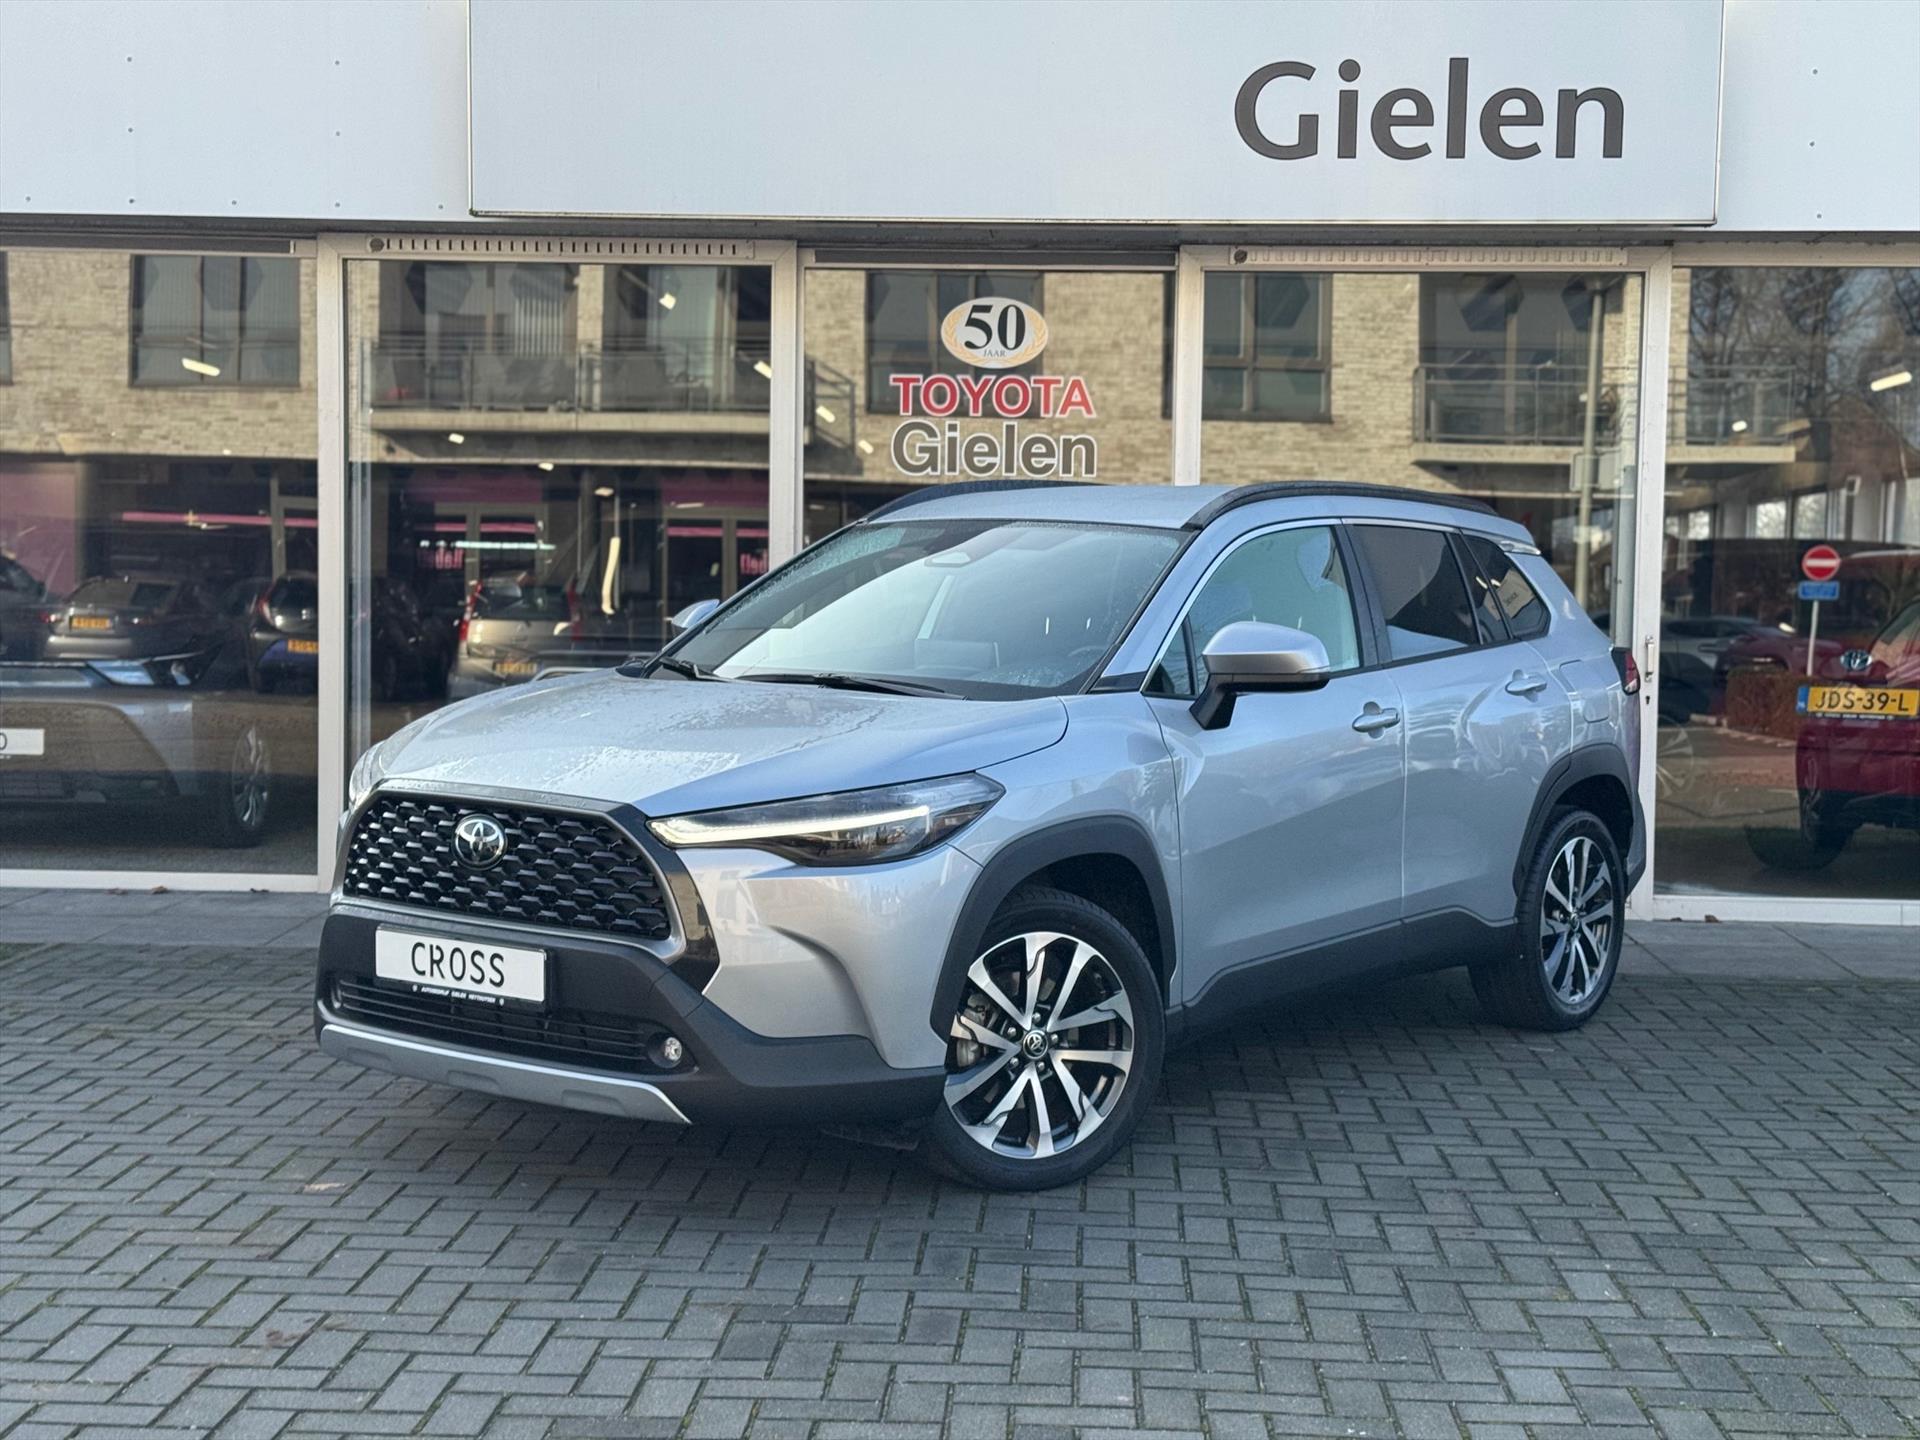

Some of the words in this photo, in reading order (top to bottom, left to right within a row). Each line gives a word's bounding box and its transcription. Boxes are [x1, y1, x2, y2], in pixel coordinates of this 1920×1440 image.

[1234, 57, 1625, 160] Gielen
[964, 304, 1026, 350] 50
[983, 349, 1007, 358] JAAR
[891, 375, 1095, 417] TOYOTA
[892, 420, 1097, 477] Gielen
[1815, 690, 1909, 712] JDS-39-L
[411, 942, 505, 988] CROSS
